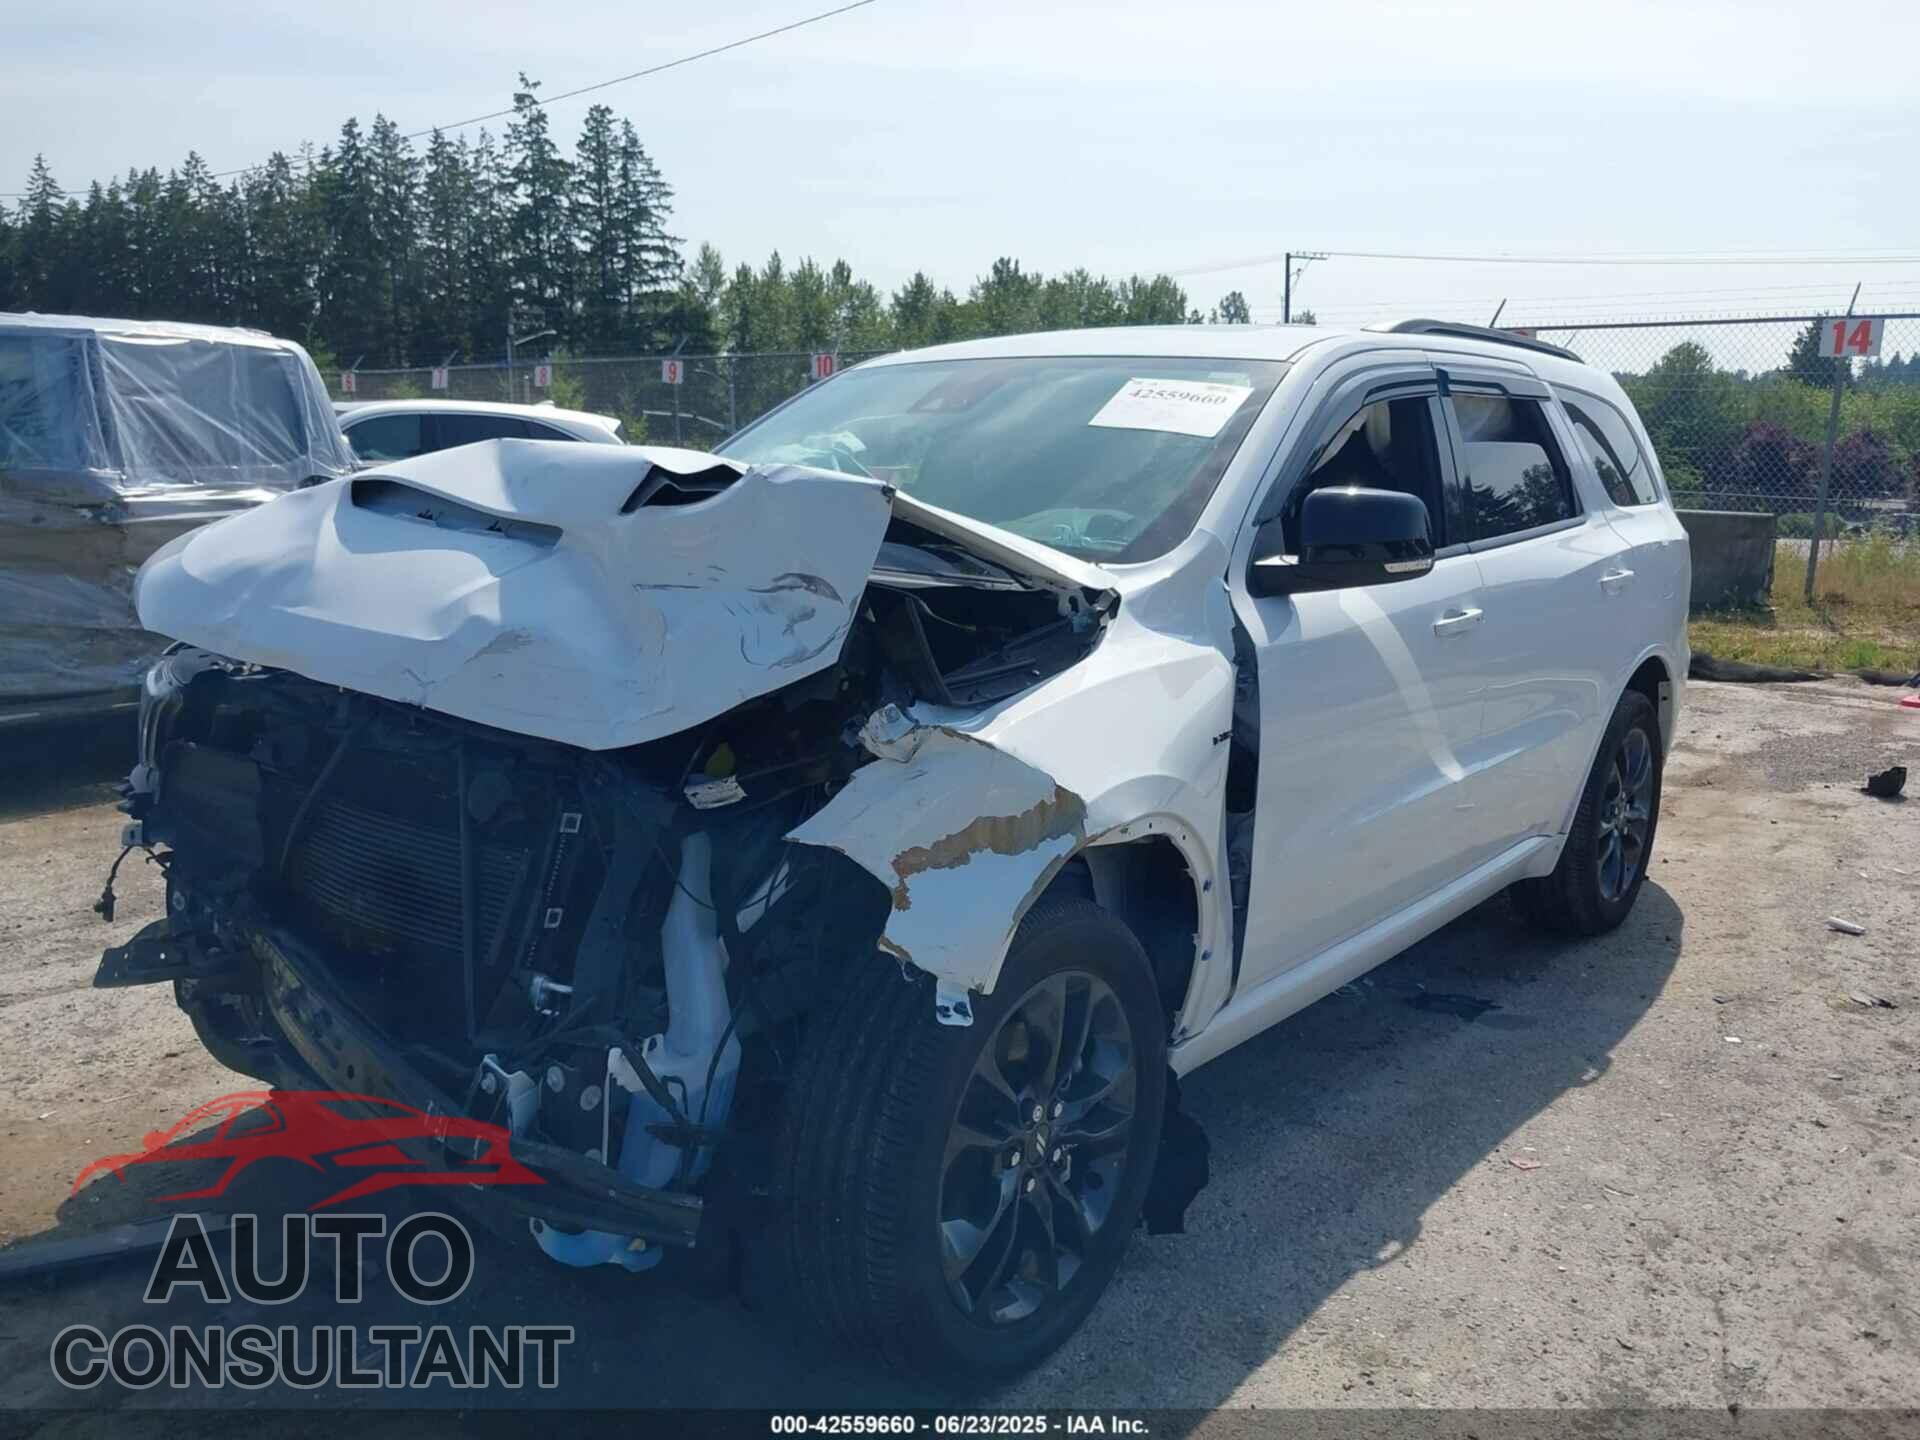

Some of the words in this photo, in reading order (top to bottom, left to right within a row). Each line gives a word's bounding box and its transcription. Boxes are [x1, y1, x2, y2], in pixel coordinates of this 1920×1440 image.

[1832, 319, 1873, 356] 14
[539, 367, 548, 385] 8
[668, 362, 678, 383] 9
[815, 354, 833, 378] 10
[1129, 388, 1228, 404] 42559660
